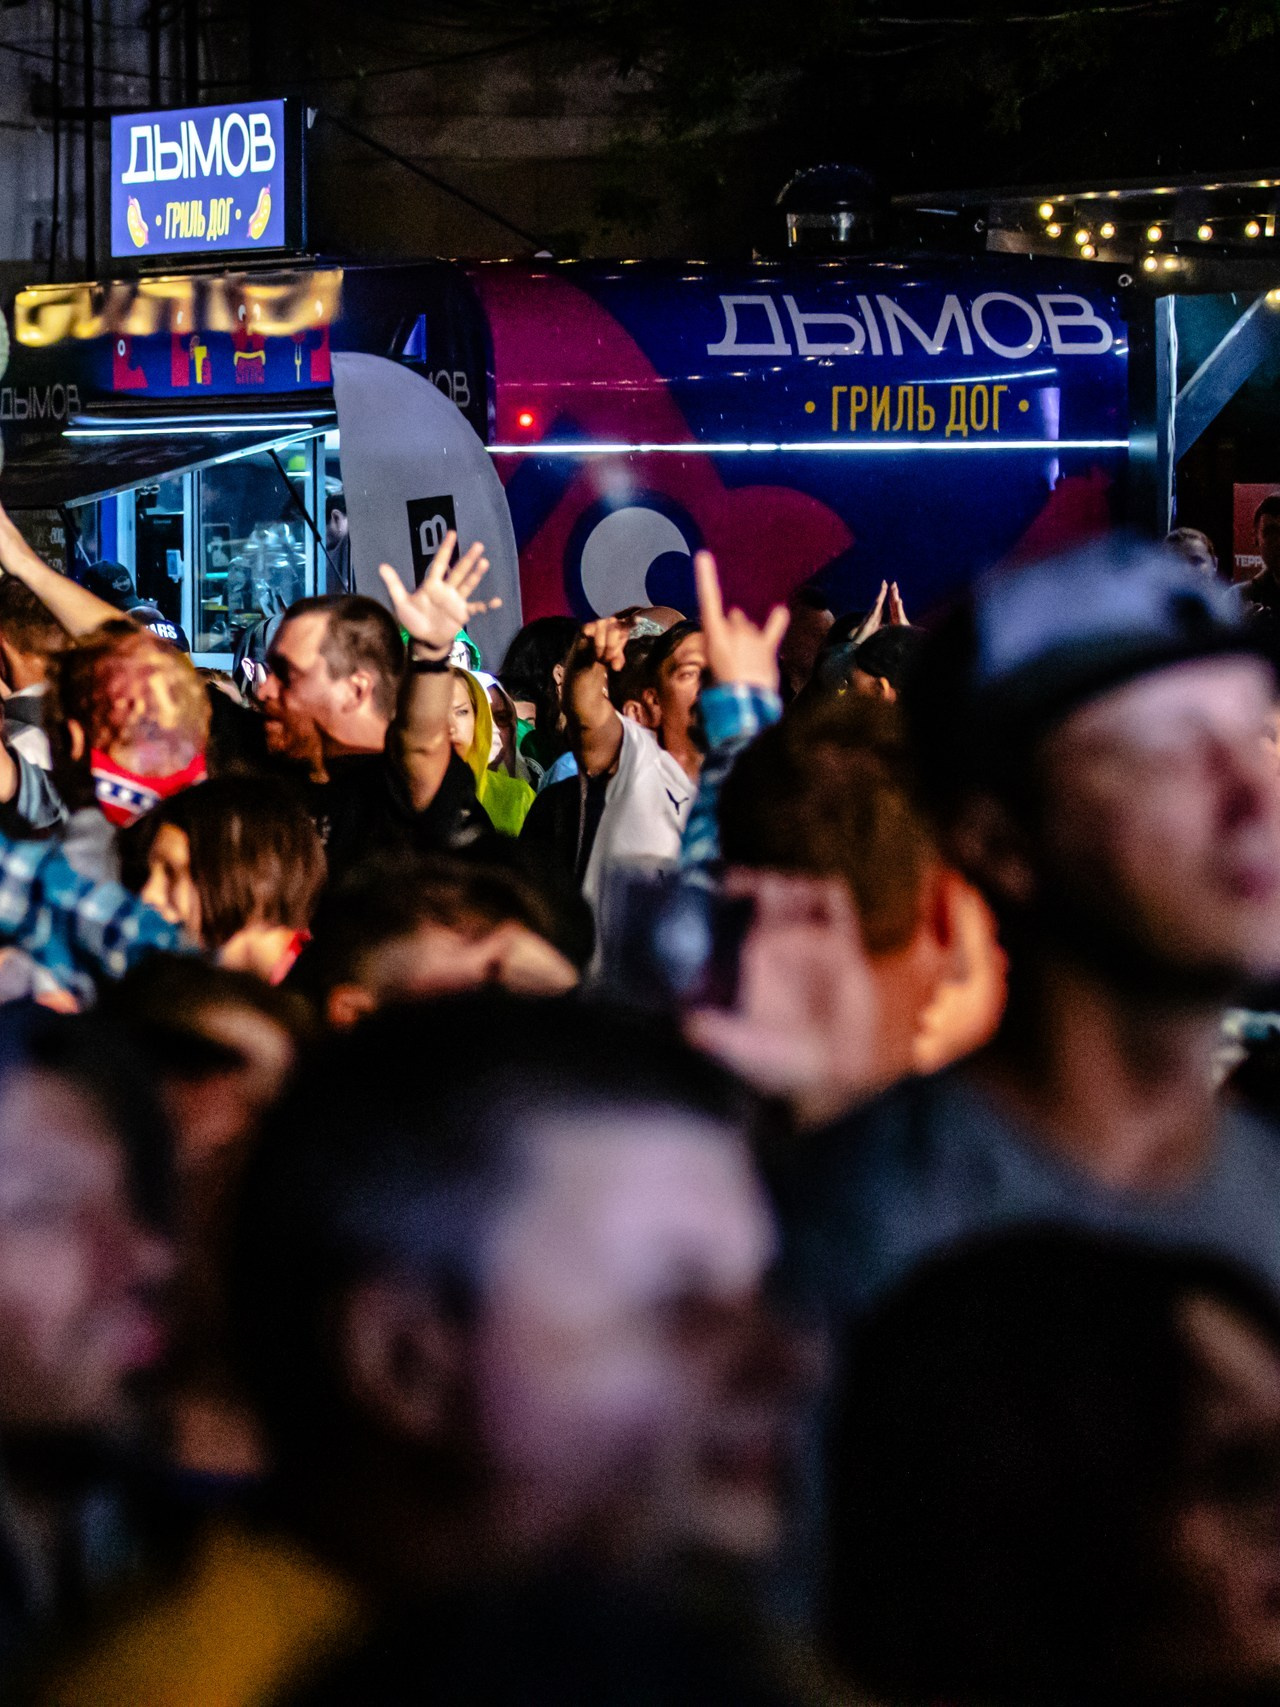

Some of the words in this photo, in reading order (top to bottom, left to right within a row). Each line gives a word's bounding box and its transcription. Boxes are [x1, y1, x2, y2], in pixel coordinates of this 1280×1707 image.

[121, 112, 276, 184] ДЫМОВ
[164, 200, 206, 240] ГРИЛЬ
[206, 197, 234, 242] ДОГ
[706, 292, 1114, 359] ДЫМОВ
[0, 383, 81, 421] ДЫМОВ
[831, 385, 937, 432] ГРИЛЬ
[945, 384, 1009, 438] ДОГ
